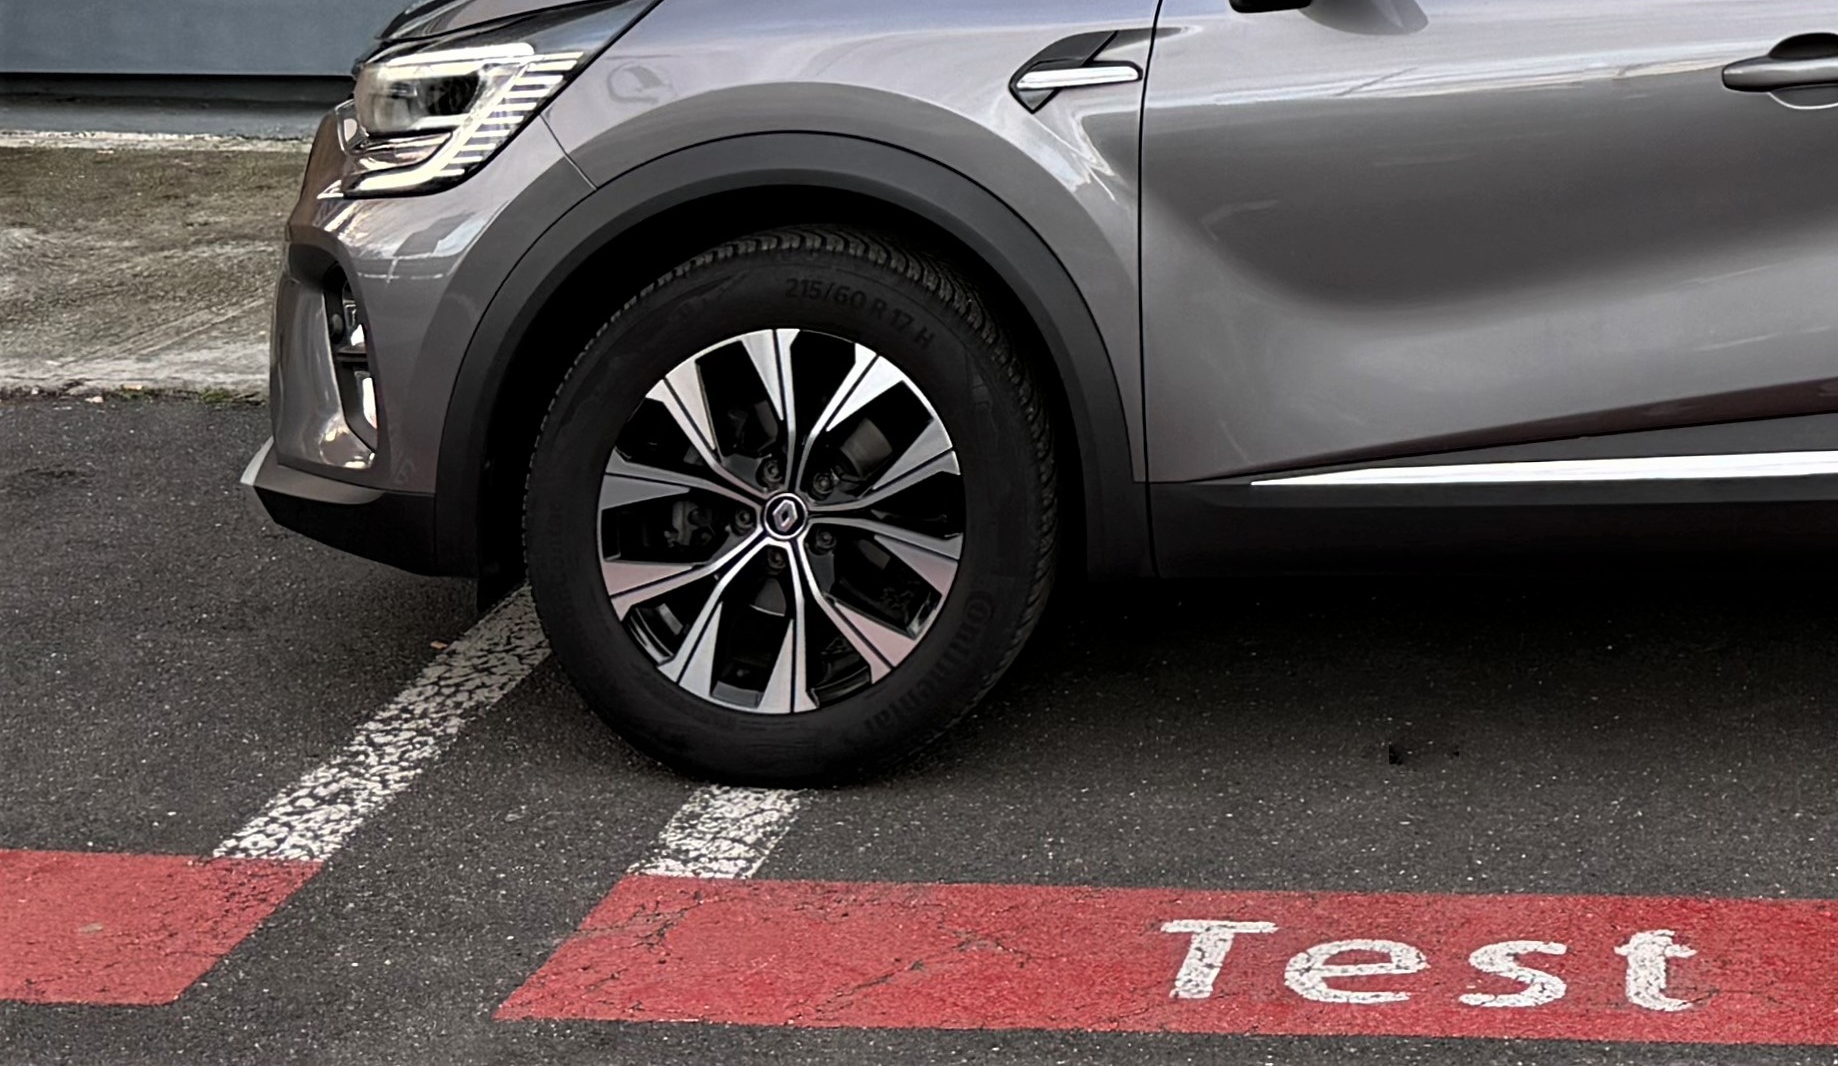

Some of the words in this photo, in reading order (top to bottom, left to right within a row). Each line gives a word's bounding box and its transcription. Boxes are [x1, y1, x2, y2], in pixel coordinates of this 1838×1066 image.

[785, 278, 866, 313] 215/60
[868, 297, 889, 321] R
[887, 307, 915, 335] 17
[912, 326, 934, 351] H
[1160, 919, 1698, 1012] Test
